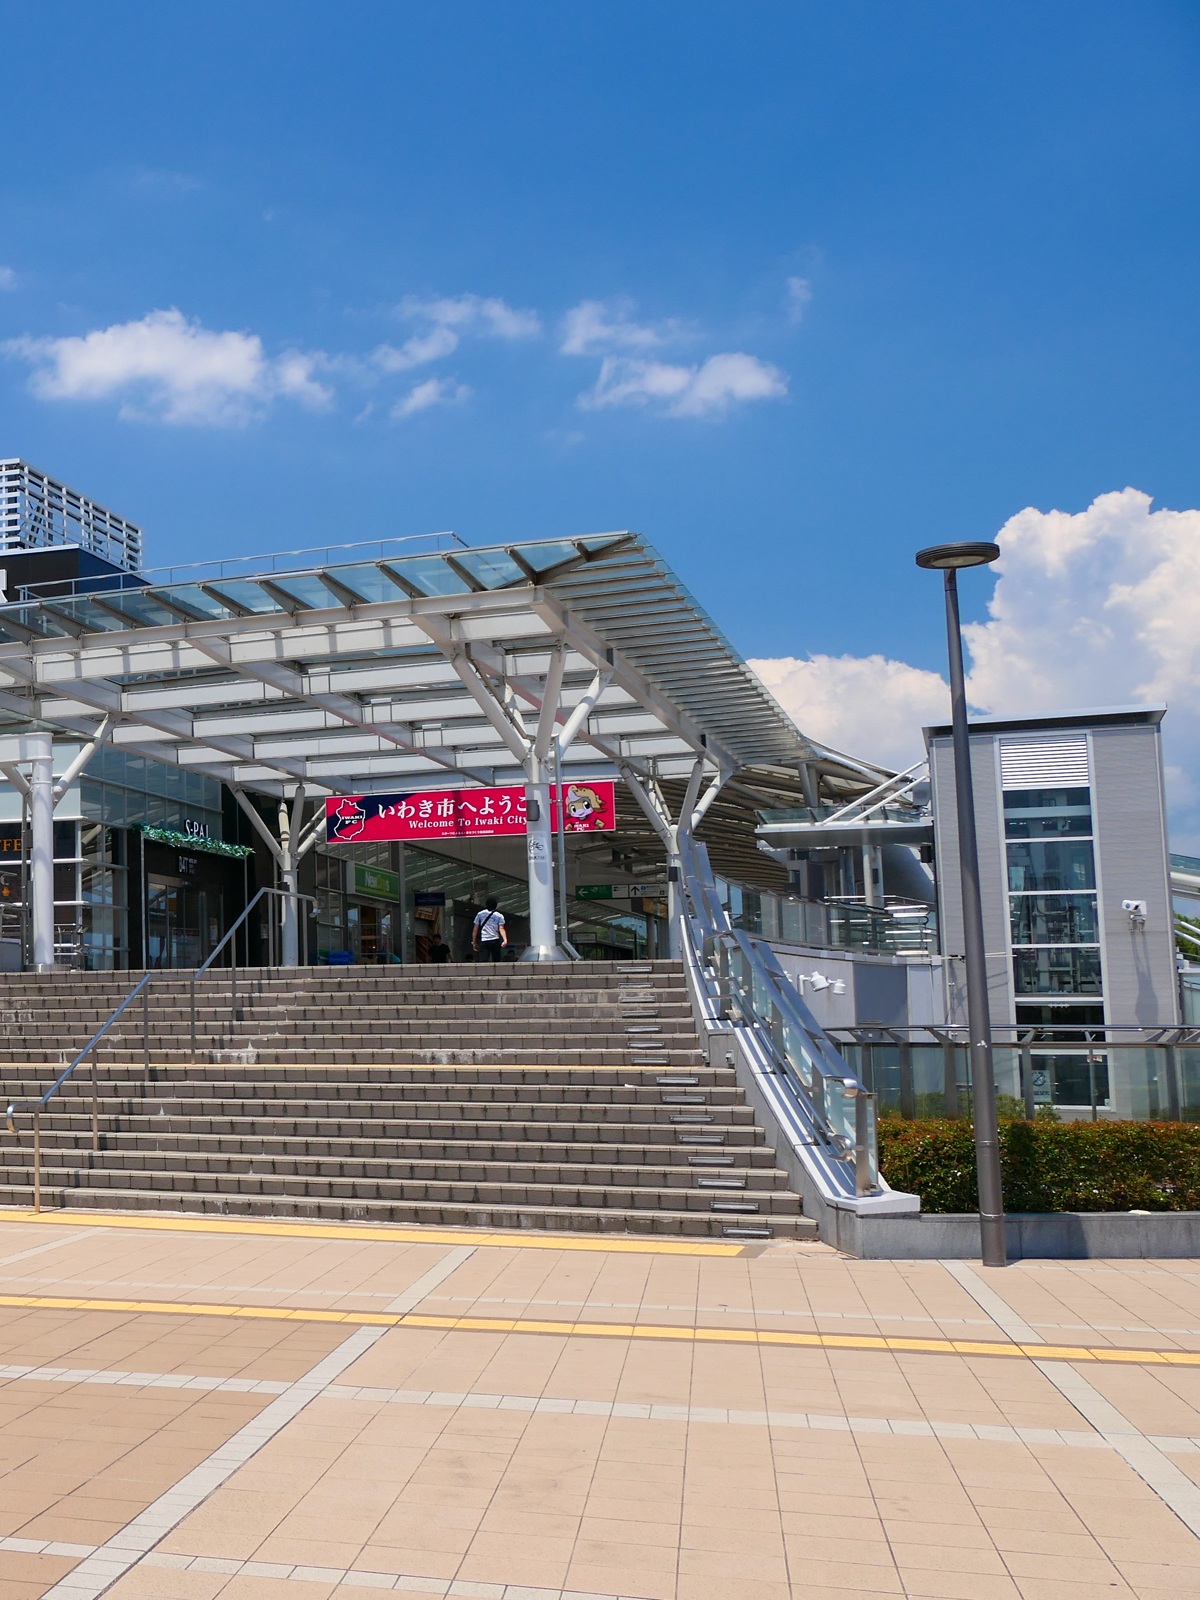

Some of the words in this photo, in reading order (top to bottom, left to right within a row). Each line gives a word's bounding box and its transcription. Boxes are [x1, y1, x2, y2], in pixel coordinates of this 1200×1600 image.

[378, 795, 527, 819] いわき市へようこ
[409, 819, 454, 829] Welcome
[457, 817, 472, 827] To
[475, 816, 504, 826] Iwaki
[507, 815, 528, 826] City
